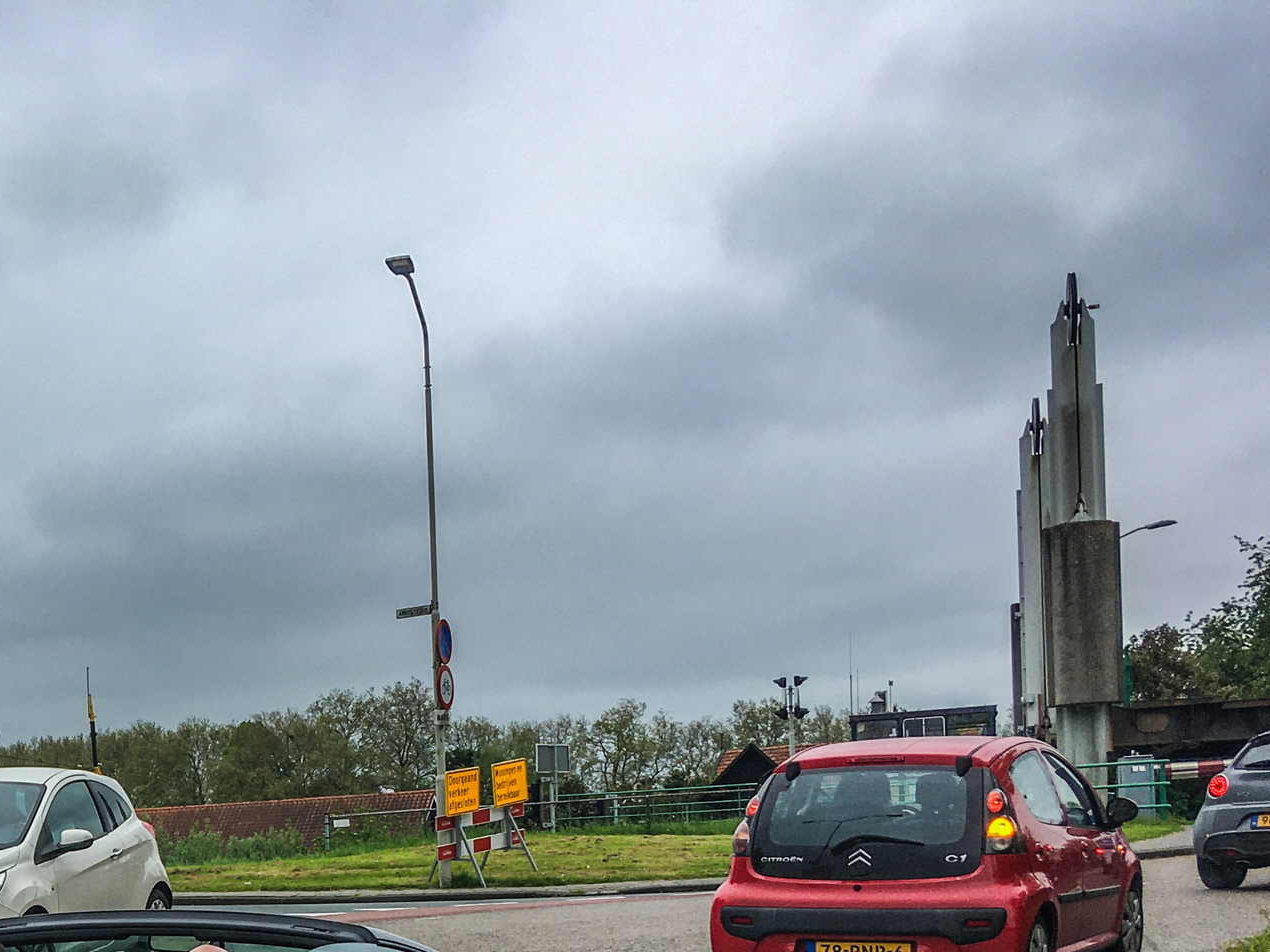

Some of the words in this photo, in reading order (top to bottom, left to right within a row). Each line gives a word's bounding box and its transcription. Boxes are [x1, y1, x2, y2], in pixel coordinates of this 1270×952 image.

[449, 772, 477, 786] Doorgaand
[449, 787, 470, 798] verkeer
[760, 855, 804, 863] CITROËN
[945, 854, 968, 863] C1
